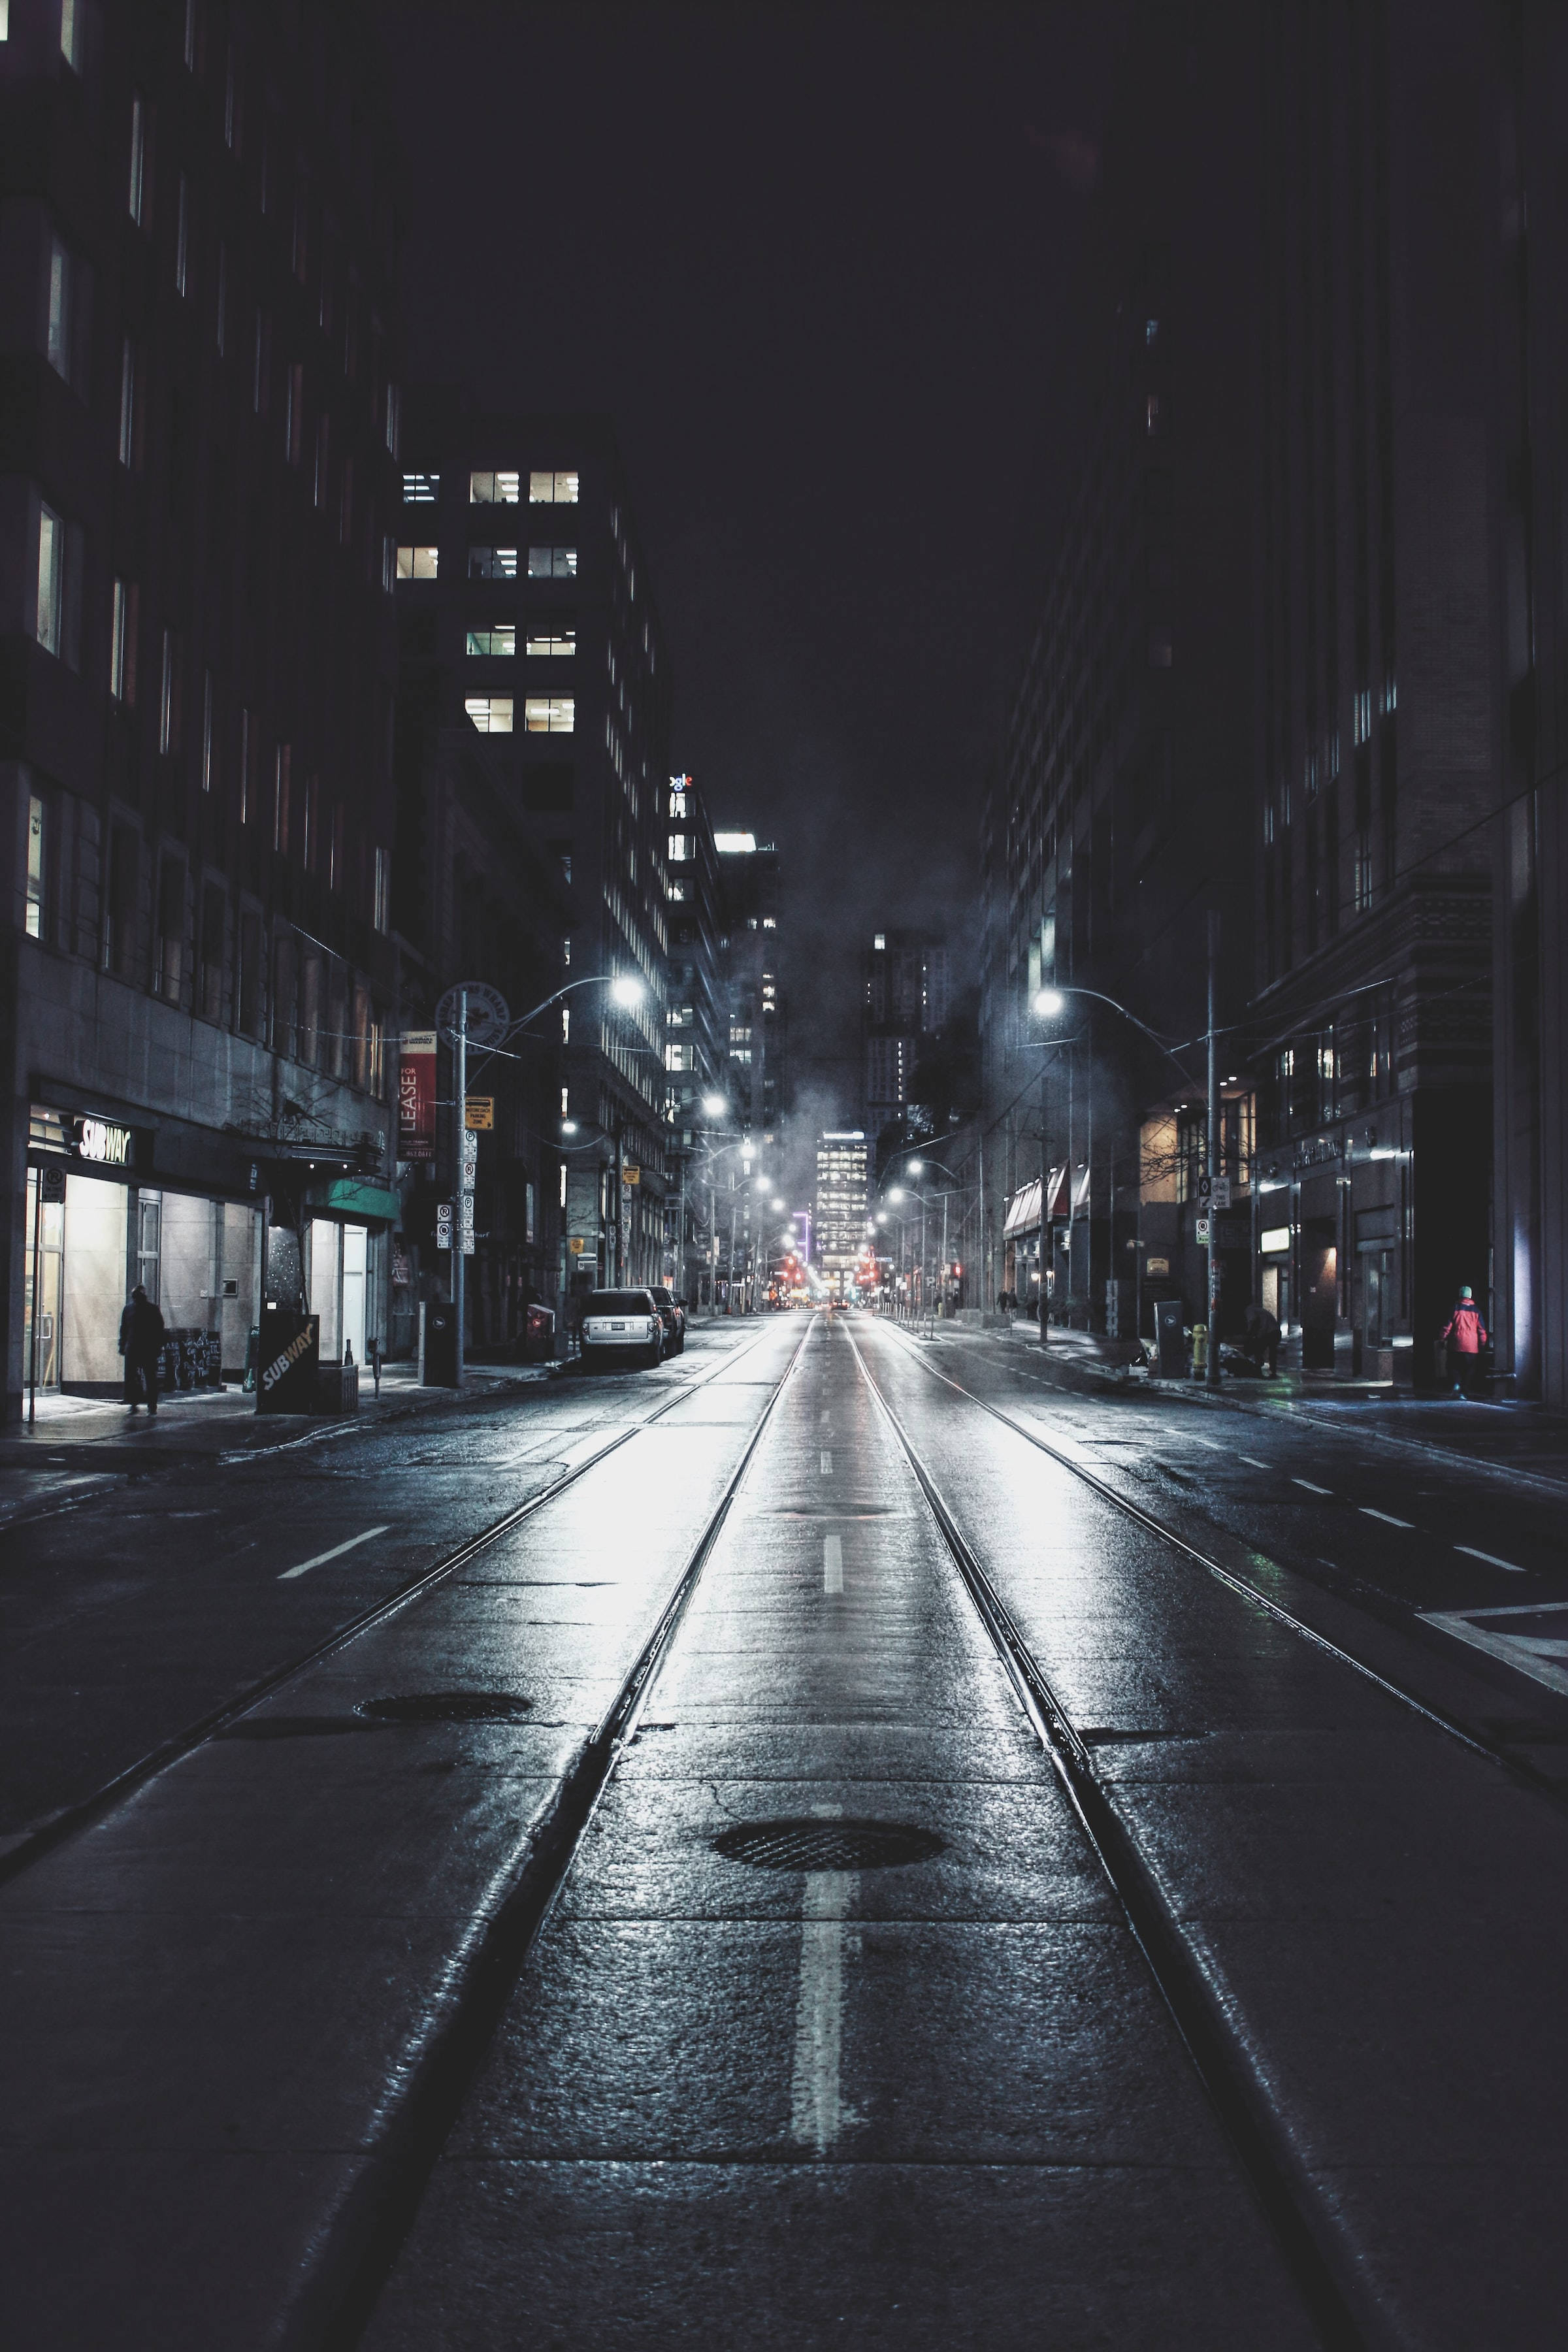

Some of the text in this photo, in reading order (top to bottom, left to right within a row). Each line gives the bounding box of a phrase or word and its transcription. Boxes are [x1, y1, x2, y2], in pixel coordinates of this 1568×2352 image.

[401, 1076, 416, 1131] LEASE
[79, 1119, 131, 1164] SUBWAY
[262, 1322, 314, 1391] SUBWAY
